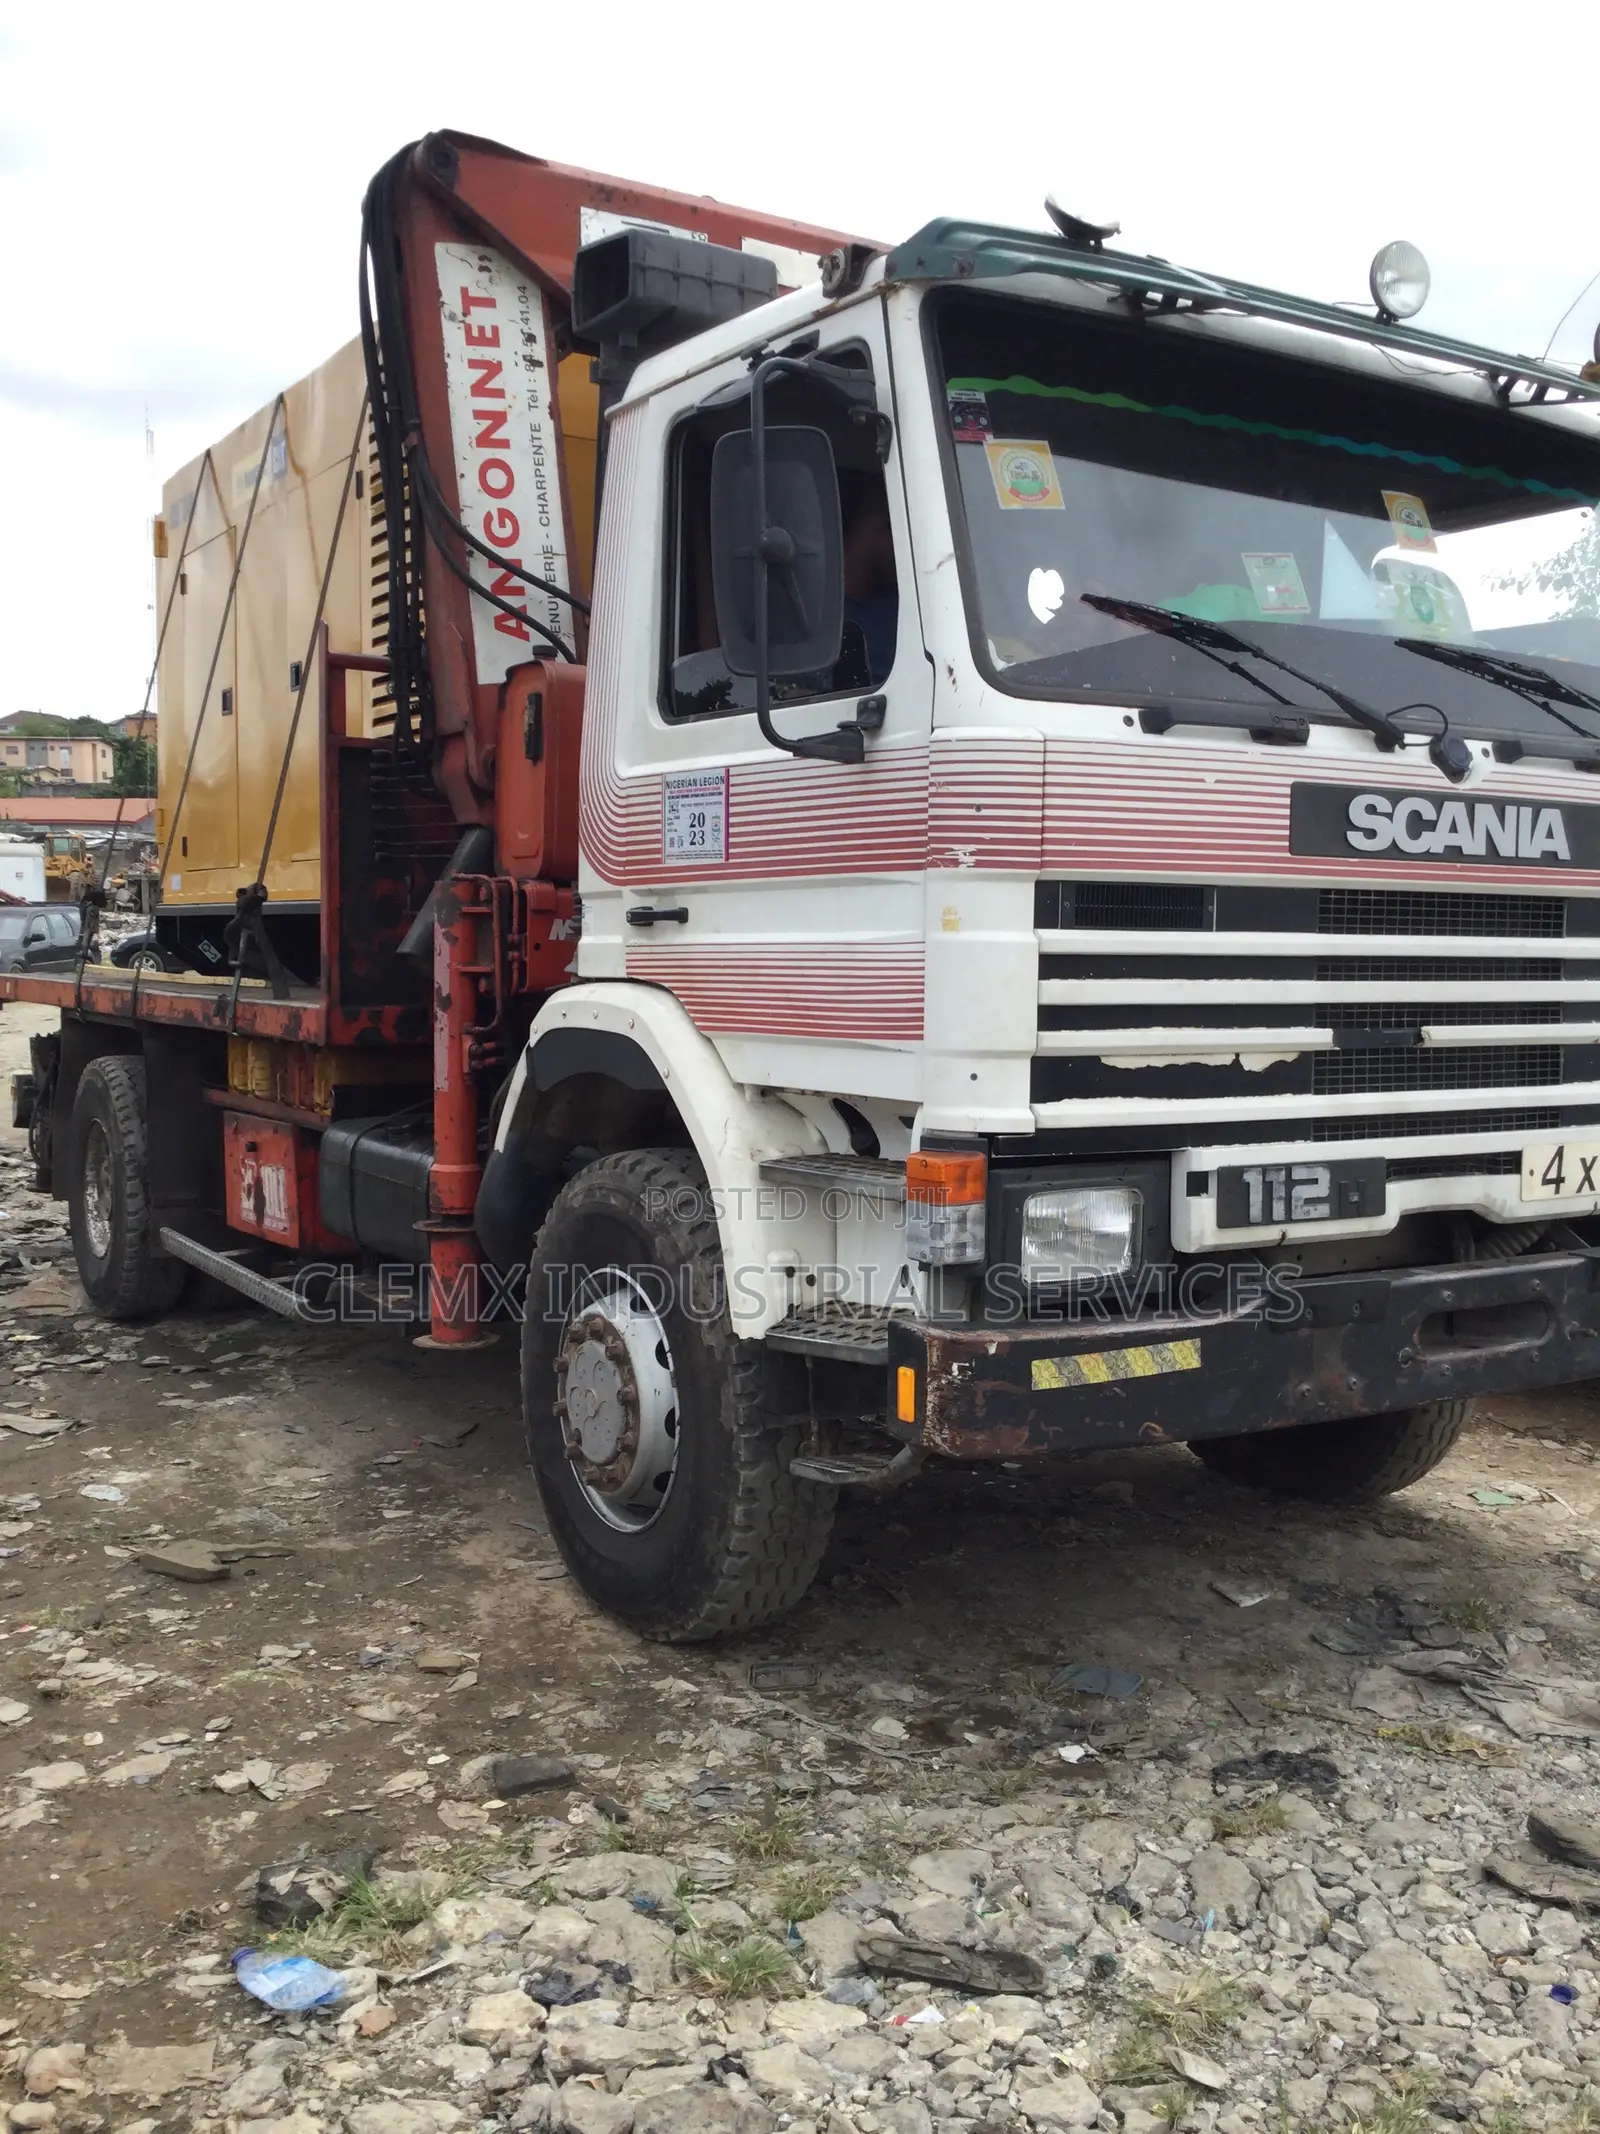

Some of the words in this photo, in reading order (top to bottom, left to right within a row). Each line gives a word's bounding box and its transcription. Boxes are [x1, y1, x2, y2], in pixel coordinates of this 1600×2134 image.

[460, 286, 531, 643] ANGONNET
[529, 422, 551, 527] CHARPENTE
[666, 778, 697, 790] NIGERIAN
[699, 776, 725, 787] LEGION
[689, 812, 706, 828] 20
[689, 830, 706, 846] 23
[1346, 794, 1571, 860] SCANIA
[1242, 1163, 1331, 1223] 112
[1541, 1145, 1566, 1195] 4
